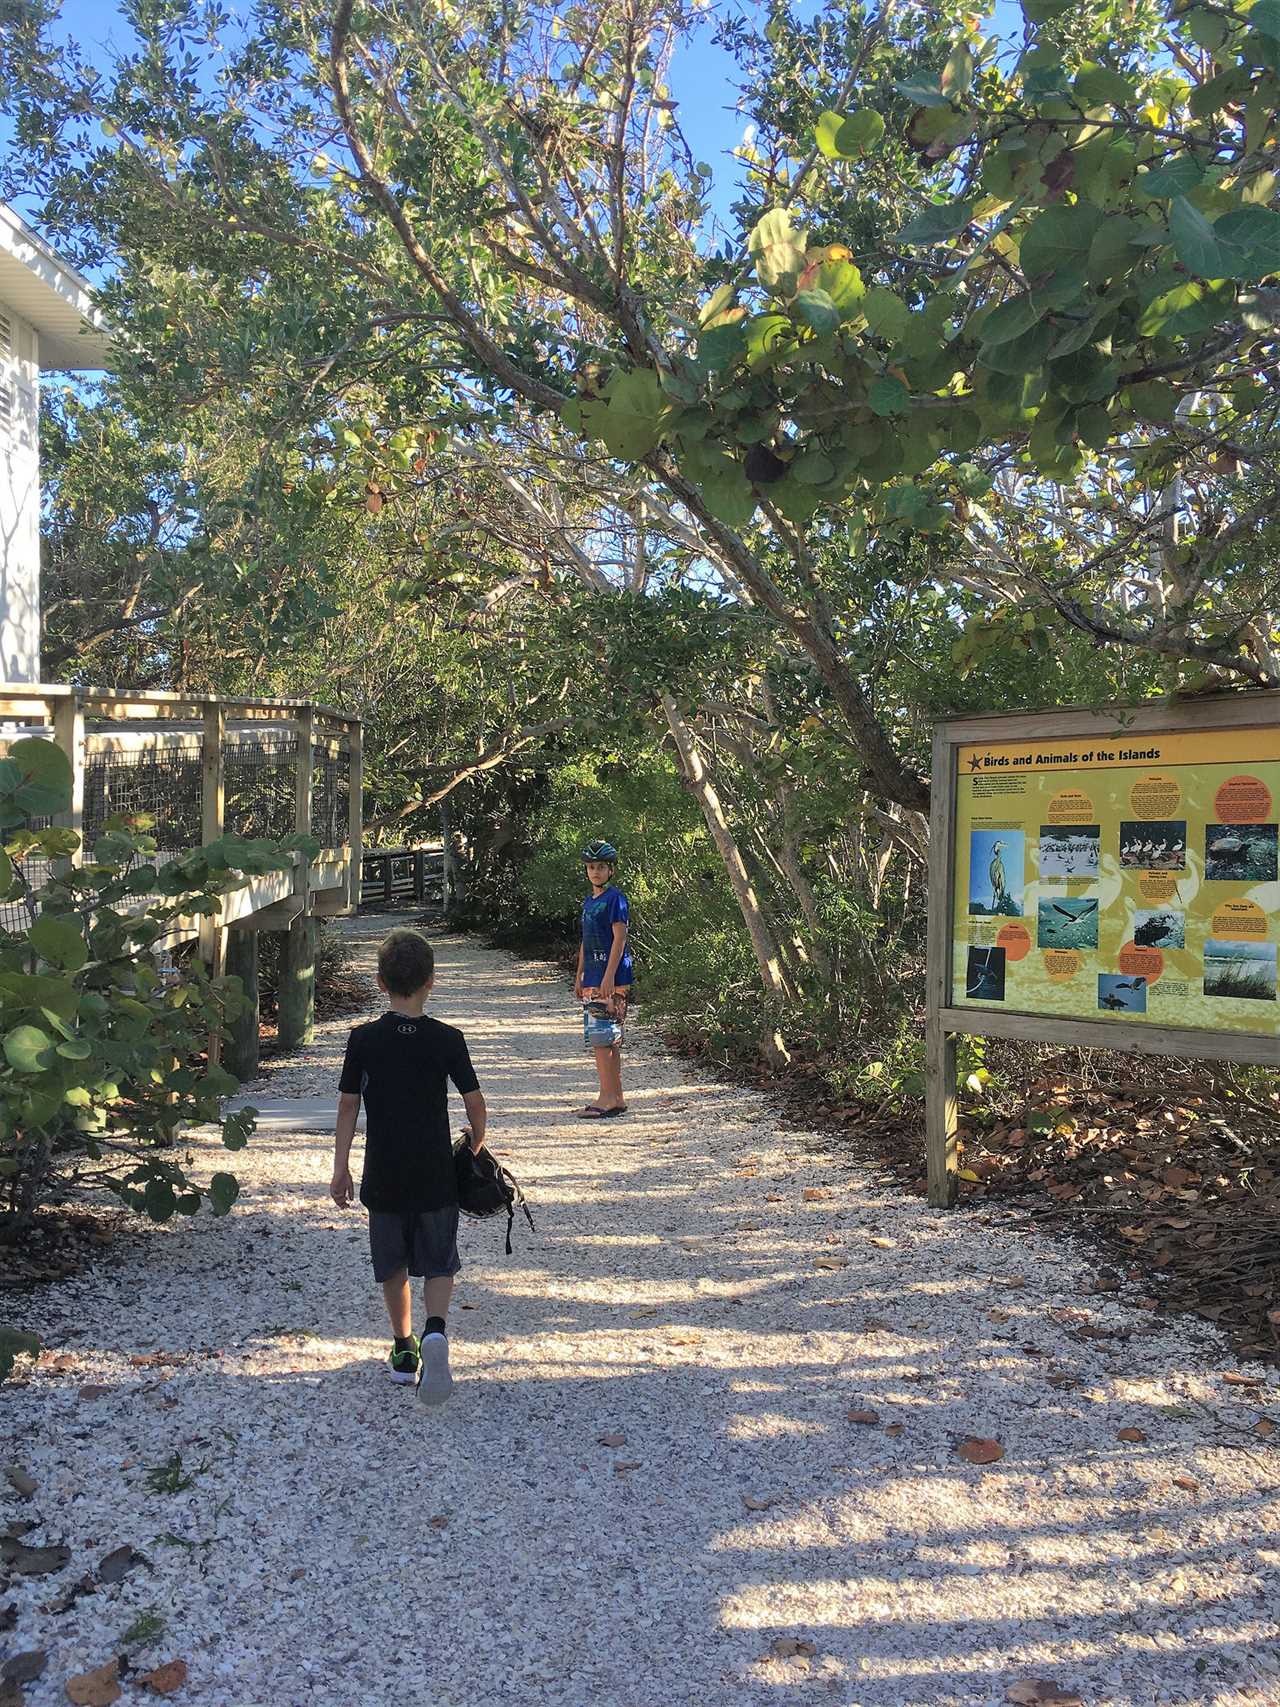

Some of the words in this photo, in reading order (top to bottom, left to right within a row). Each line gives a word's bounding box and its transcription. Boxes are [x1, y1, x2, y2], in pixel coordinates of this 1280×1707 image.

[983, 754, 1010, 767] Birds
[1012, 753, 1032, 765] and
[1035, 752, 1077, 764] Animals
[1081, 751, 1094, 761] of
[1096, 750, 1115, 761] the
[1118, 748, 1161, 760] Islands
